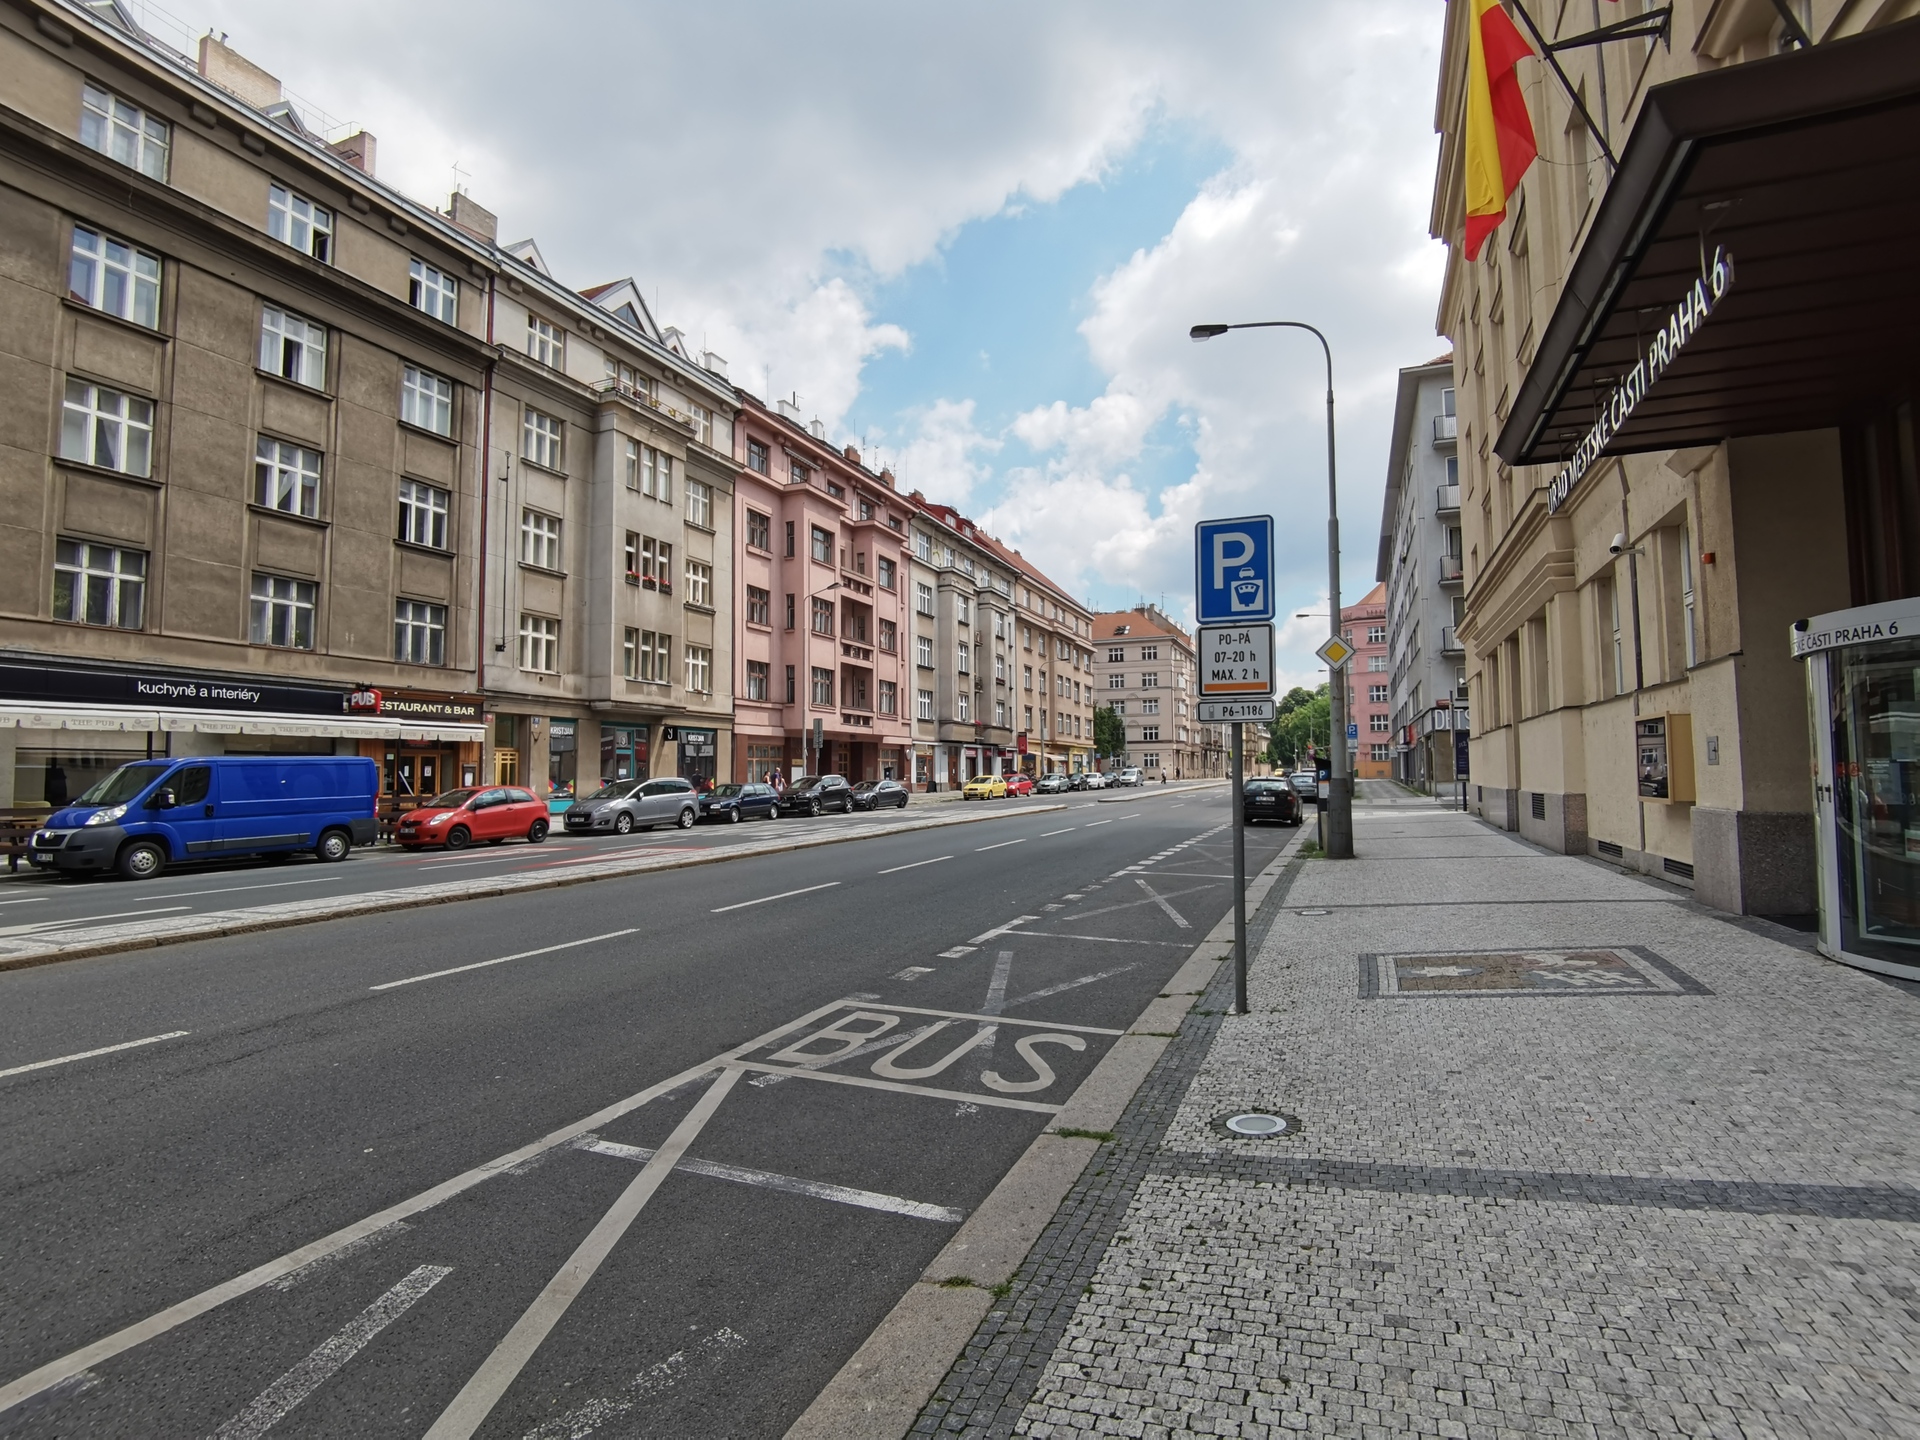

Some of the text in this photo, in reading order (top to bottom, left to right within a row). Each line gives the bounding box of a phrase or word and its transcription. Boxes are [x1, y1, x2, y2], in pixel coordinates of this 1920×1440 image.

[1568, 401, 1610, 489] MĚSTSKÉ
[1611, 359, 1646, 431] ČÁSTI
[1649, 278, 1710, 384] PRAHA
[1712, 245, 1726, 298] 6
[1213, 532, 1255, 590] P
[1219, 630, 1251, 645] PO-PÁ
[1806, 633, 1831, 650] ČÁSTI
[1835, 624, 1883, 643] PRAHA
[1889, 621, 1898, 635] 6
[1214, 650, 1256, 663] 07-20 h
[1212, 668, 1259, 681] MAX. 2 h
[138, 681, 261, 703] kuchyně a interiéry
[351, 691, 376, 706] PUB
[379, 701, 443, 713] ESTAURANT
[444, 705, 452, 714] &
[454, 707, 475, 716] BAR
[1222, 705, 1263, 717] P6-1186
[71, 718, 115, 727] THE PUB
[1319, 770, 1326, 779] P
[766, 1010, 1088, 1093] BUS
